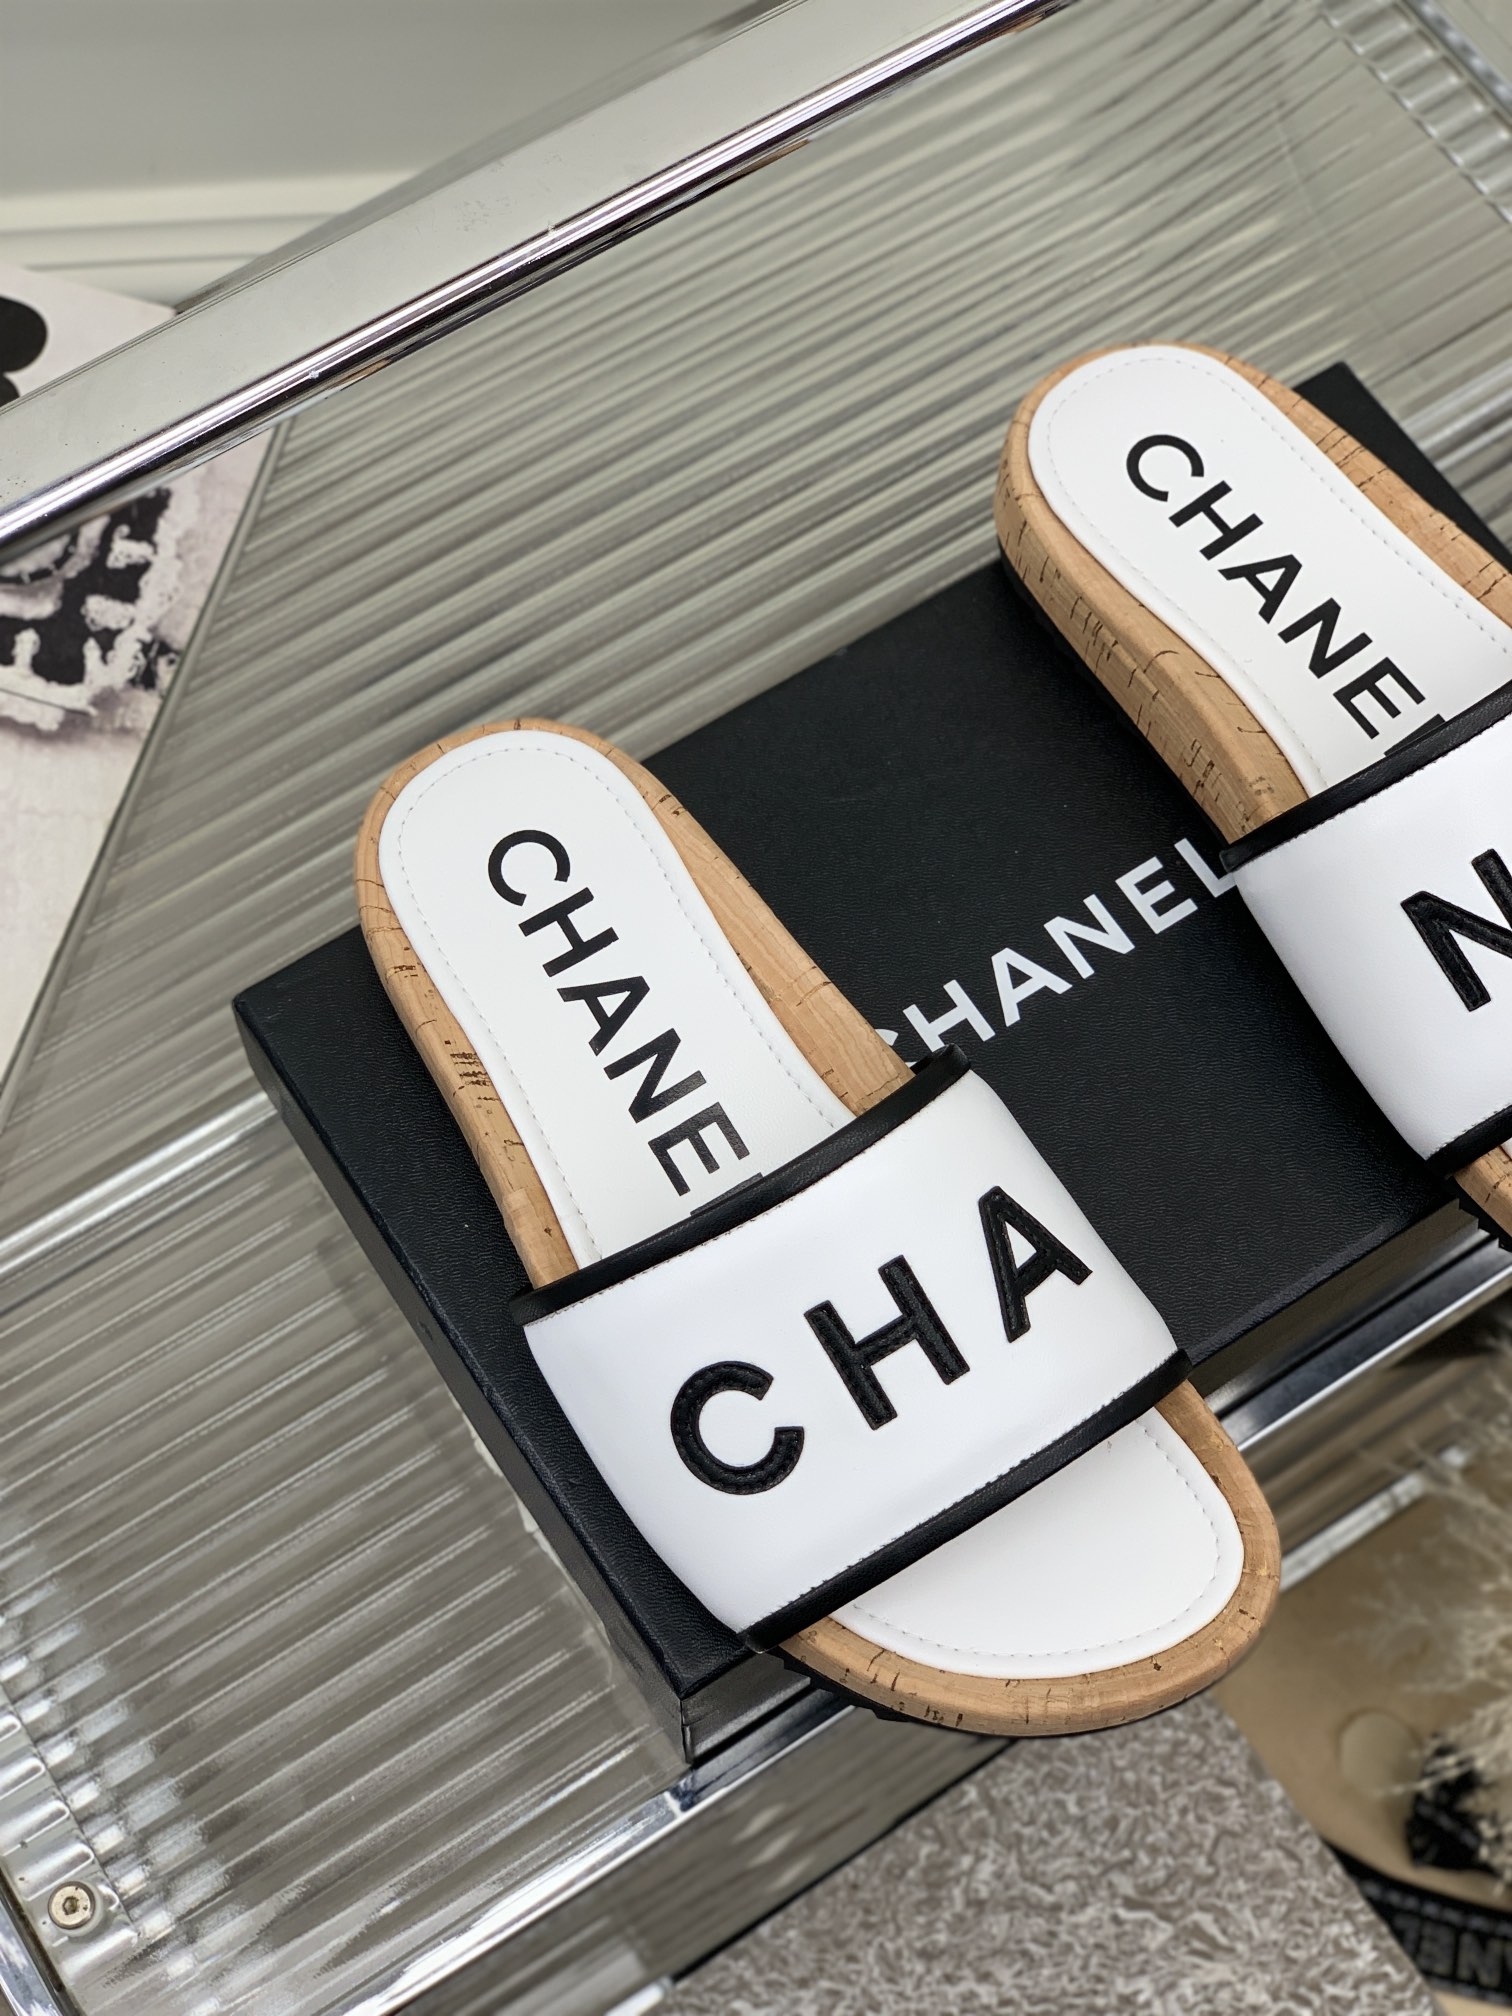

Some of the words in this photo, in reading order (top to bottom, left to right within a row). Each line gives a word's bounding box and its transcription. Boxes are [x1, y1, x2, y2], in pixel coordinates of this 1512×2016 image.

[1126, 434, 1446, 757] CHANE
[488, 829, 763, 1217] CHANE
[866, 837, 1237, 1067] HANEL
[670, 1186, 1093, 1494] CHA
